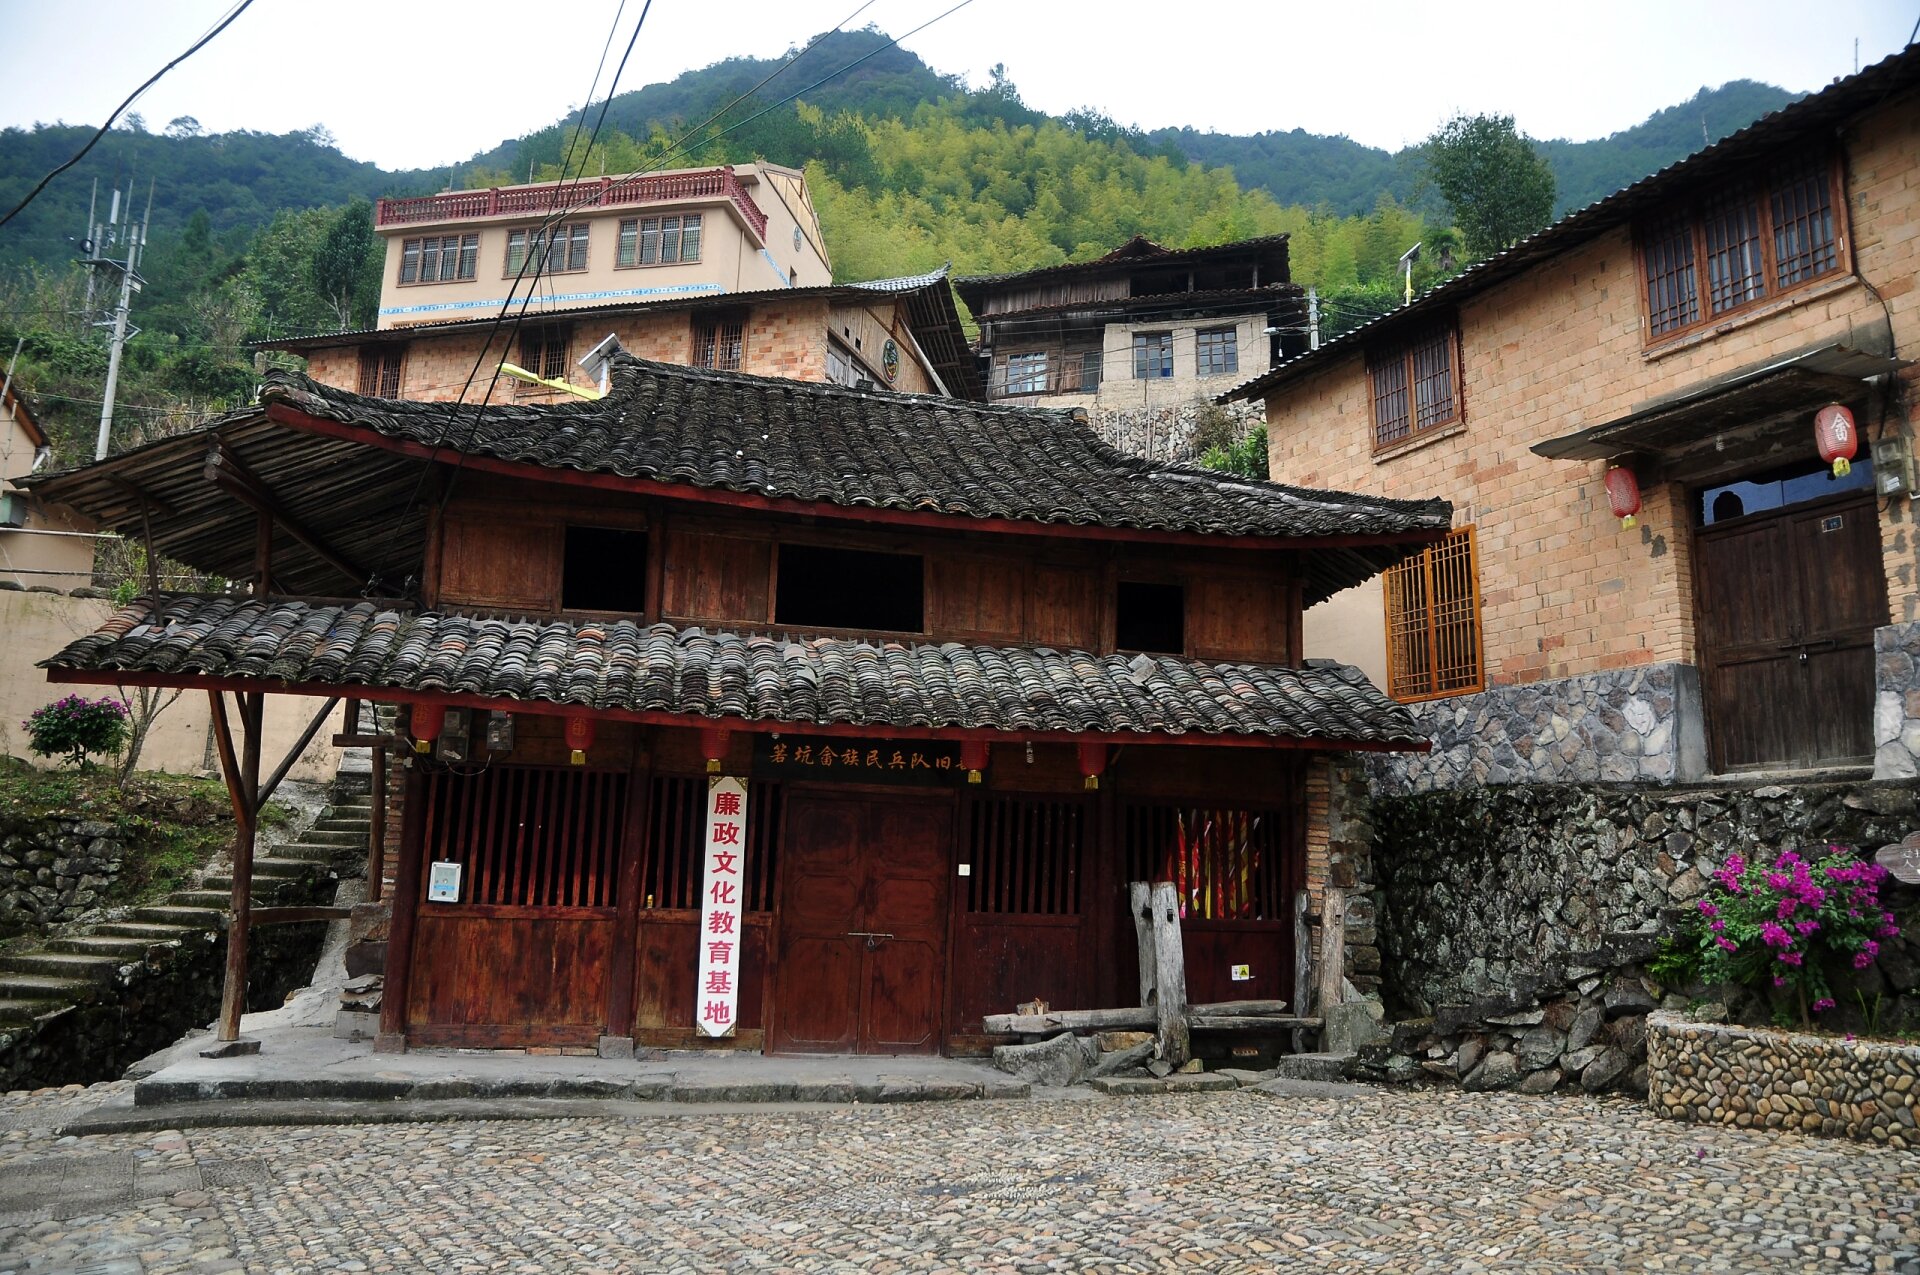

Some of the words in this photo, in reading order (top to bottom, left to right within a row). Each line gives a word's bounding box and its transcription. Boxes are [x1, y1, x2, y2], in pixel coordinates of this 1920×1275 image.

[703, 791, 742, 1025] 廉政文化教育基地
